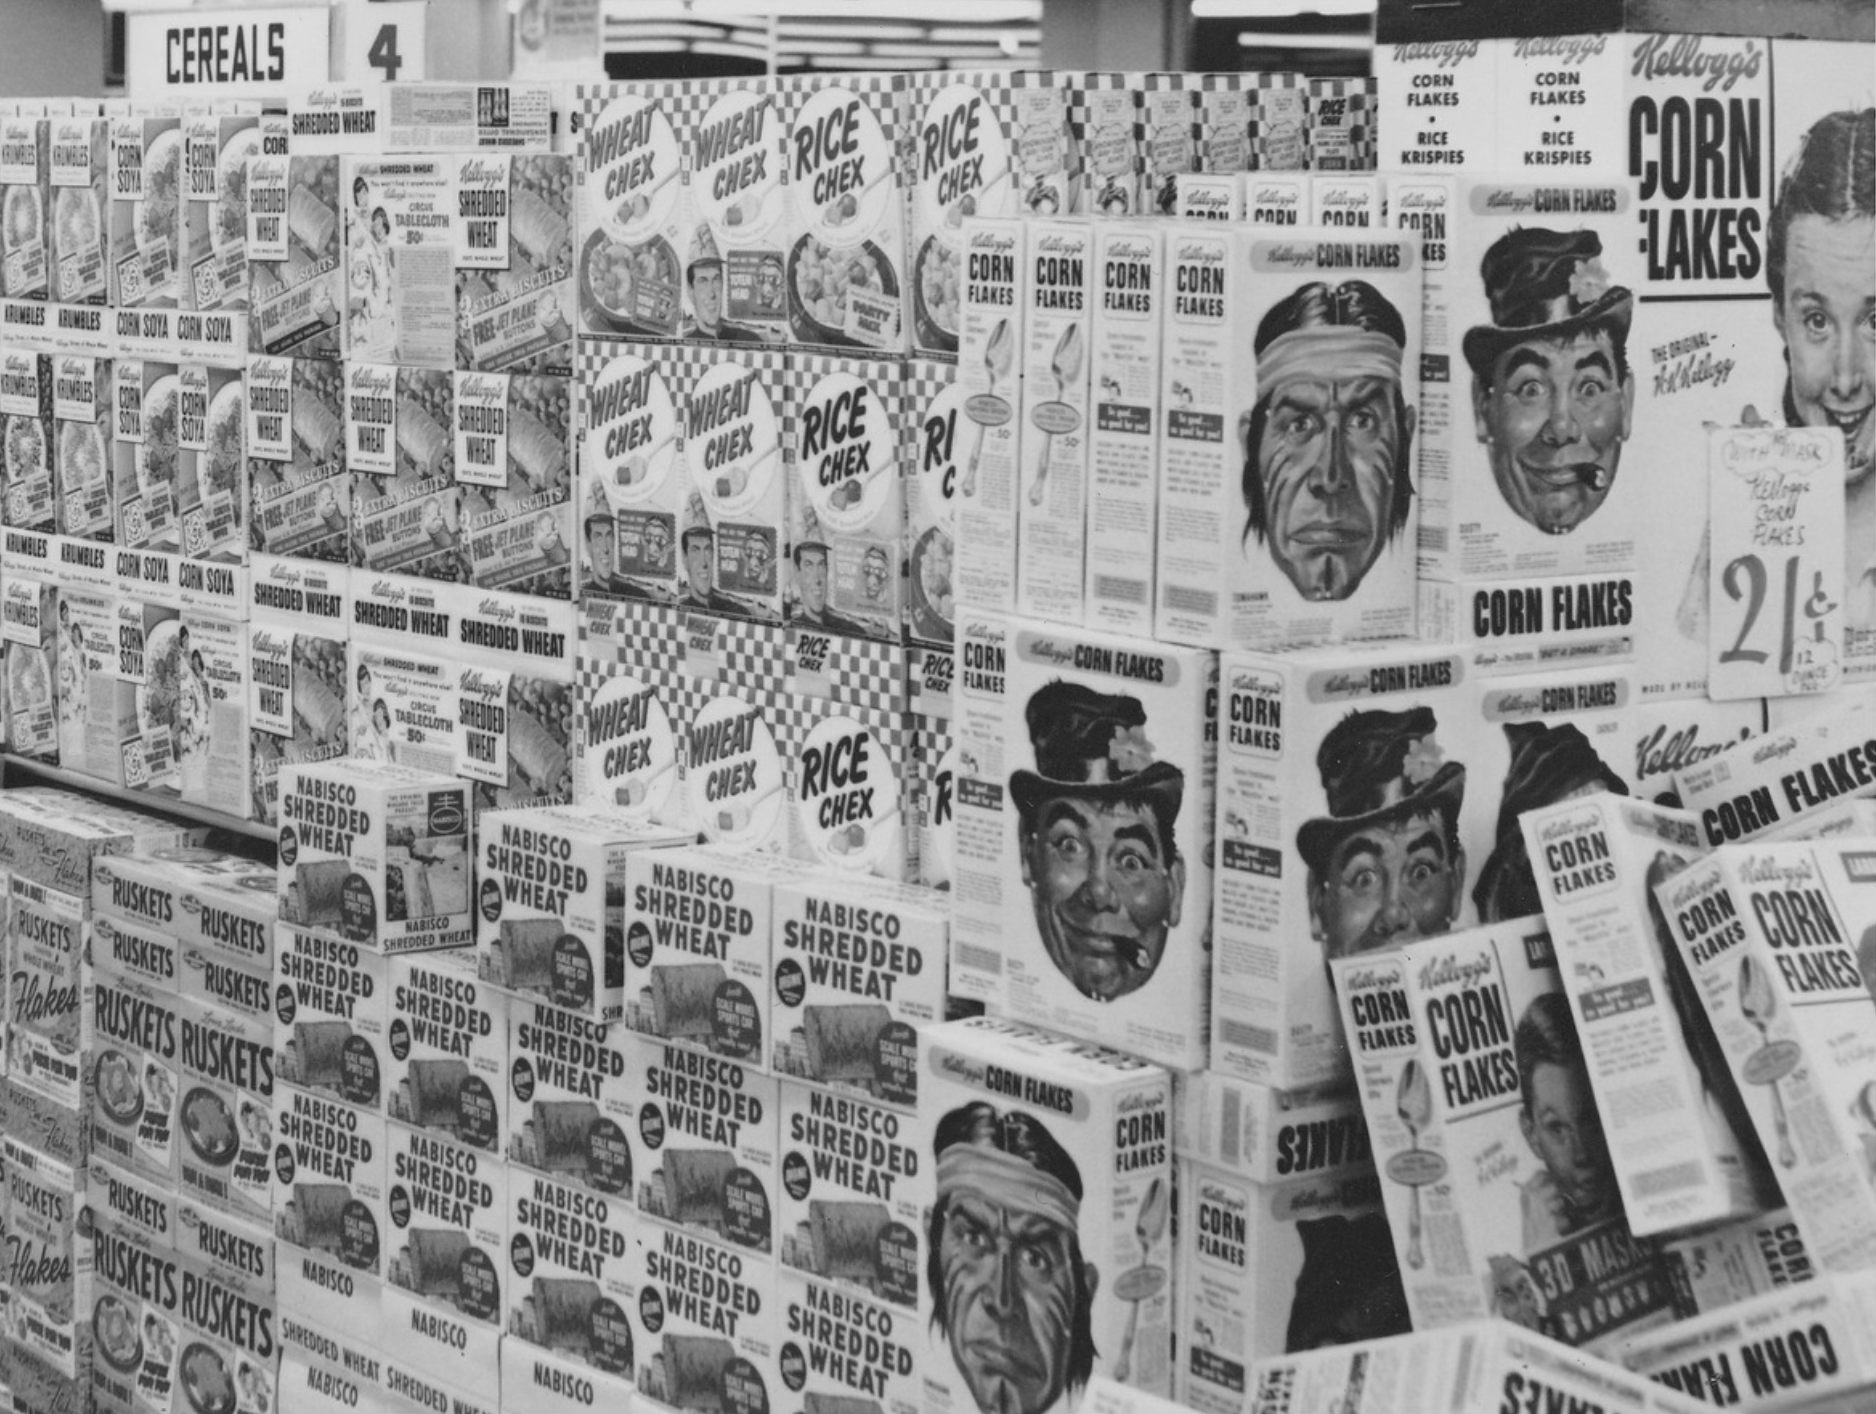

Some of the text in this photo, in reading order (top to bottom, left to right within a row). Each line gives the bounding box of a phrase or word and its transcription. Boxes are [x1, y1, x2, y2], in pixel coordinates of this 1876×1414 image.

[166, 22, 285, 84] CEREALS
[367, 23, 403, 81] 4
[1631, 34, 1764, 92] Kellogg's
[1407, 91, 1459, 107] FLAKES
[1412, 73, 1454, 88] CORN
[1530, 89, 1586, 105] FLAKES
[292, 111, 340, 135] SHREDDED
[1318, 98, 1347, 118] RICE
[589, 101, 657, 173] WHEAT
[696, 98, 770, 172] WHEAT
[795, 99, 860, 181] RICE
[923, 96, 981, 181] RICE
[1401, 149, 1465, 165] KRISPIES
[1417, 131, 1448, 146] RICE
[1541, 130, 1575, 146] RICE
[1628, 95, 1761, 200] CORN
[604, 151, 655, 200] CHEX
[712, 149, 767, 200] CHEX
[813, 154, 864, 205] CHEX
[937, 153, 984, 206] CHEX
[1524, 149, 1592, 166] KRISPIES
[395, 214, 450, 228] TABLECLOTH
[1316, 243, 1401, 268] CORN FLAKES
[1638, 206, 1762, 281] LAKES
[968, 252, 1014, 283] CORN
[1036, 256, 1083, 287] CORN
[1176, 265, 1224, 294] CORN
[4, 304, 45, 326] KRUMBLES
[968, 284, 1014, 306] FLAKES
[1035, 289, 1083, 311] FLAKES
[1103, 292, 1151, 313] FLAKES
[1175, 296, 1224, 318] FLAKES
[58, 308, 101, 331] KRUMBLES
[144, 313, 169, 338] SOYA
[590, 364, 657, 430] WHEAT
[688, 371, 758, 439] WHEAT
[605, 412, 654, 459] CHEX
[802, 385, 868, 460] RICE
[924, 407, 956, 471] RI
[704, 422, 754, 471] CHEX
[819, 440, 871, 486] CHEX
[1756, 503, 1798, 522] CORN
[5, 531, 48, 558] KRUMBLES
[61, 542, 104, 569] KRUMBLES
[143, 555, 169, 584] SOYA
[207, 566, 234, 596] SOYA
[254, 582, 342, 619] SHREDDED WHEAT
[1473, 579, 1633, 637] CORN FLAKES
[460, 618, 518, 652] SHREDDED
[796, 633, 830, 659] RICE
[964, 641, 1006, 672] CORN
[798, 656, 824, 674] CHEX
[963, 671, 1005, 694] FLAKES
[1074, 643, 1164, 683] CORN FLAKES
[1370, 660, 1452, 694] CORN FLAKES
[588, 687, 655, 748] WHEAT
[1230, 693, 1281, 729] CORN
[1541, 681, 1617, 713] CORN FLAKES
[395, 708, 453, 733] TABLECLOTH
[688, 708, 761, 769] WHEAT
[1230, 725, 1280, 751] FLAKES
[603, 737, 652, 779] CHEX
[801, 731, 869, 800] RICE
[297, 775, 356, 806] NABISCO
[706, 759, 757, 802] CHEX
[284, 794, 370, 835] SHREDDED
[818, 787, 874, 830] CHEX
[1702, 786, 1781, 848] CORN
[299, 823, 354, 857] WHEAT
[502, 823, 571, 861] NABISCO
[1545, 830, 1610, 873] CORN
[486, 843, 588, 894] SHREDDED
[1553, 861, 1617, 896] FLAKES
[112, 877, 173, 928] RUSKETS
[1678, 887, 1737, 942] CORN
[1750, 888, 1843, 950] CORN
[19, 909, 71, 953] RUSKETS
[201, 905, 265, 955] RUSKETS
[294, 933, 358, 968] NABISCO
[784, 919, 923, 976] SHREDDED
[1691, 920, 1746, 966] FLAKES
[113, 930, 174, 978] RUSKETS
[281, 951, 374, 999] SHREDDED
[1775, 948, 1862, 993] FLAKES
[12, 970, 81, 1023] Flakes
[409, 967, 476, 1005] NABISCO
[1351, 989, 1411, 1027] CORN
[95, 983, 176, 1059] RUSKETS
[534, 1003, 607, 1044] NABISCO
[1357, 1024, 1417, 1051] FLAKES
[1426, 983, 1509, 1060] CORN
[182, 1018, 274, 1097] RUSKETS
[518, 1022, 625, 1078] SHREDDED
[663, 1045, 743, 1090] NABISCO
[535, 1056, 604, 1100] WHEAT
[986, 1065, 1073, 1115] CORN FLAKES
[1441, 1048, 1520, 1109] FLAKES
[294, 1093, 357, 1132] NABISCO
[811, 1091, 899, 1140] NABISCO
[1115, 1110, 1166, 1149] CORN
[791, 1113, 919, 1178] SHREDDED
[1115, 1144, 1166, 1173] FLAKES
[395, 1152, 493, 1209] SHREDDED
[534, 1179, 608, 1224] NABISCO
[108, 1178, 167, 1233] RUSKETS
[411, 1185, 475, 1229] WHEAT
[517, 1197, 626, 1258] SHREDDED
[1200, 1203, 1246, 1245] CORN
[6, 1234, 71, 1287] Flakes
[200, 1220, 265, 1277] RUSKETS
[536, 1233, 605, 1280] WHEAT
[663, 1230, 742, 1279] NABISCO
[1199, 1234, 1246, 1268] FLAKES
[302, 1258, 354, 1298] NABISCO
[1536, 1250, 1575, 1301] 3D
[807, 1284, 892, 1337] NABISCO
[787, 1303, 913, 1377] SHREDDED
[1741, 1323, 1839, 1397] CORN
[808, 1342, 889, 1399] WHEAT
